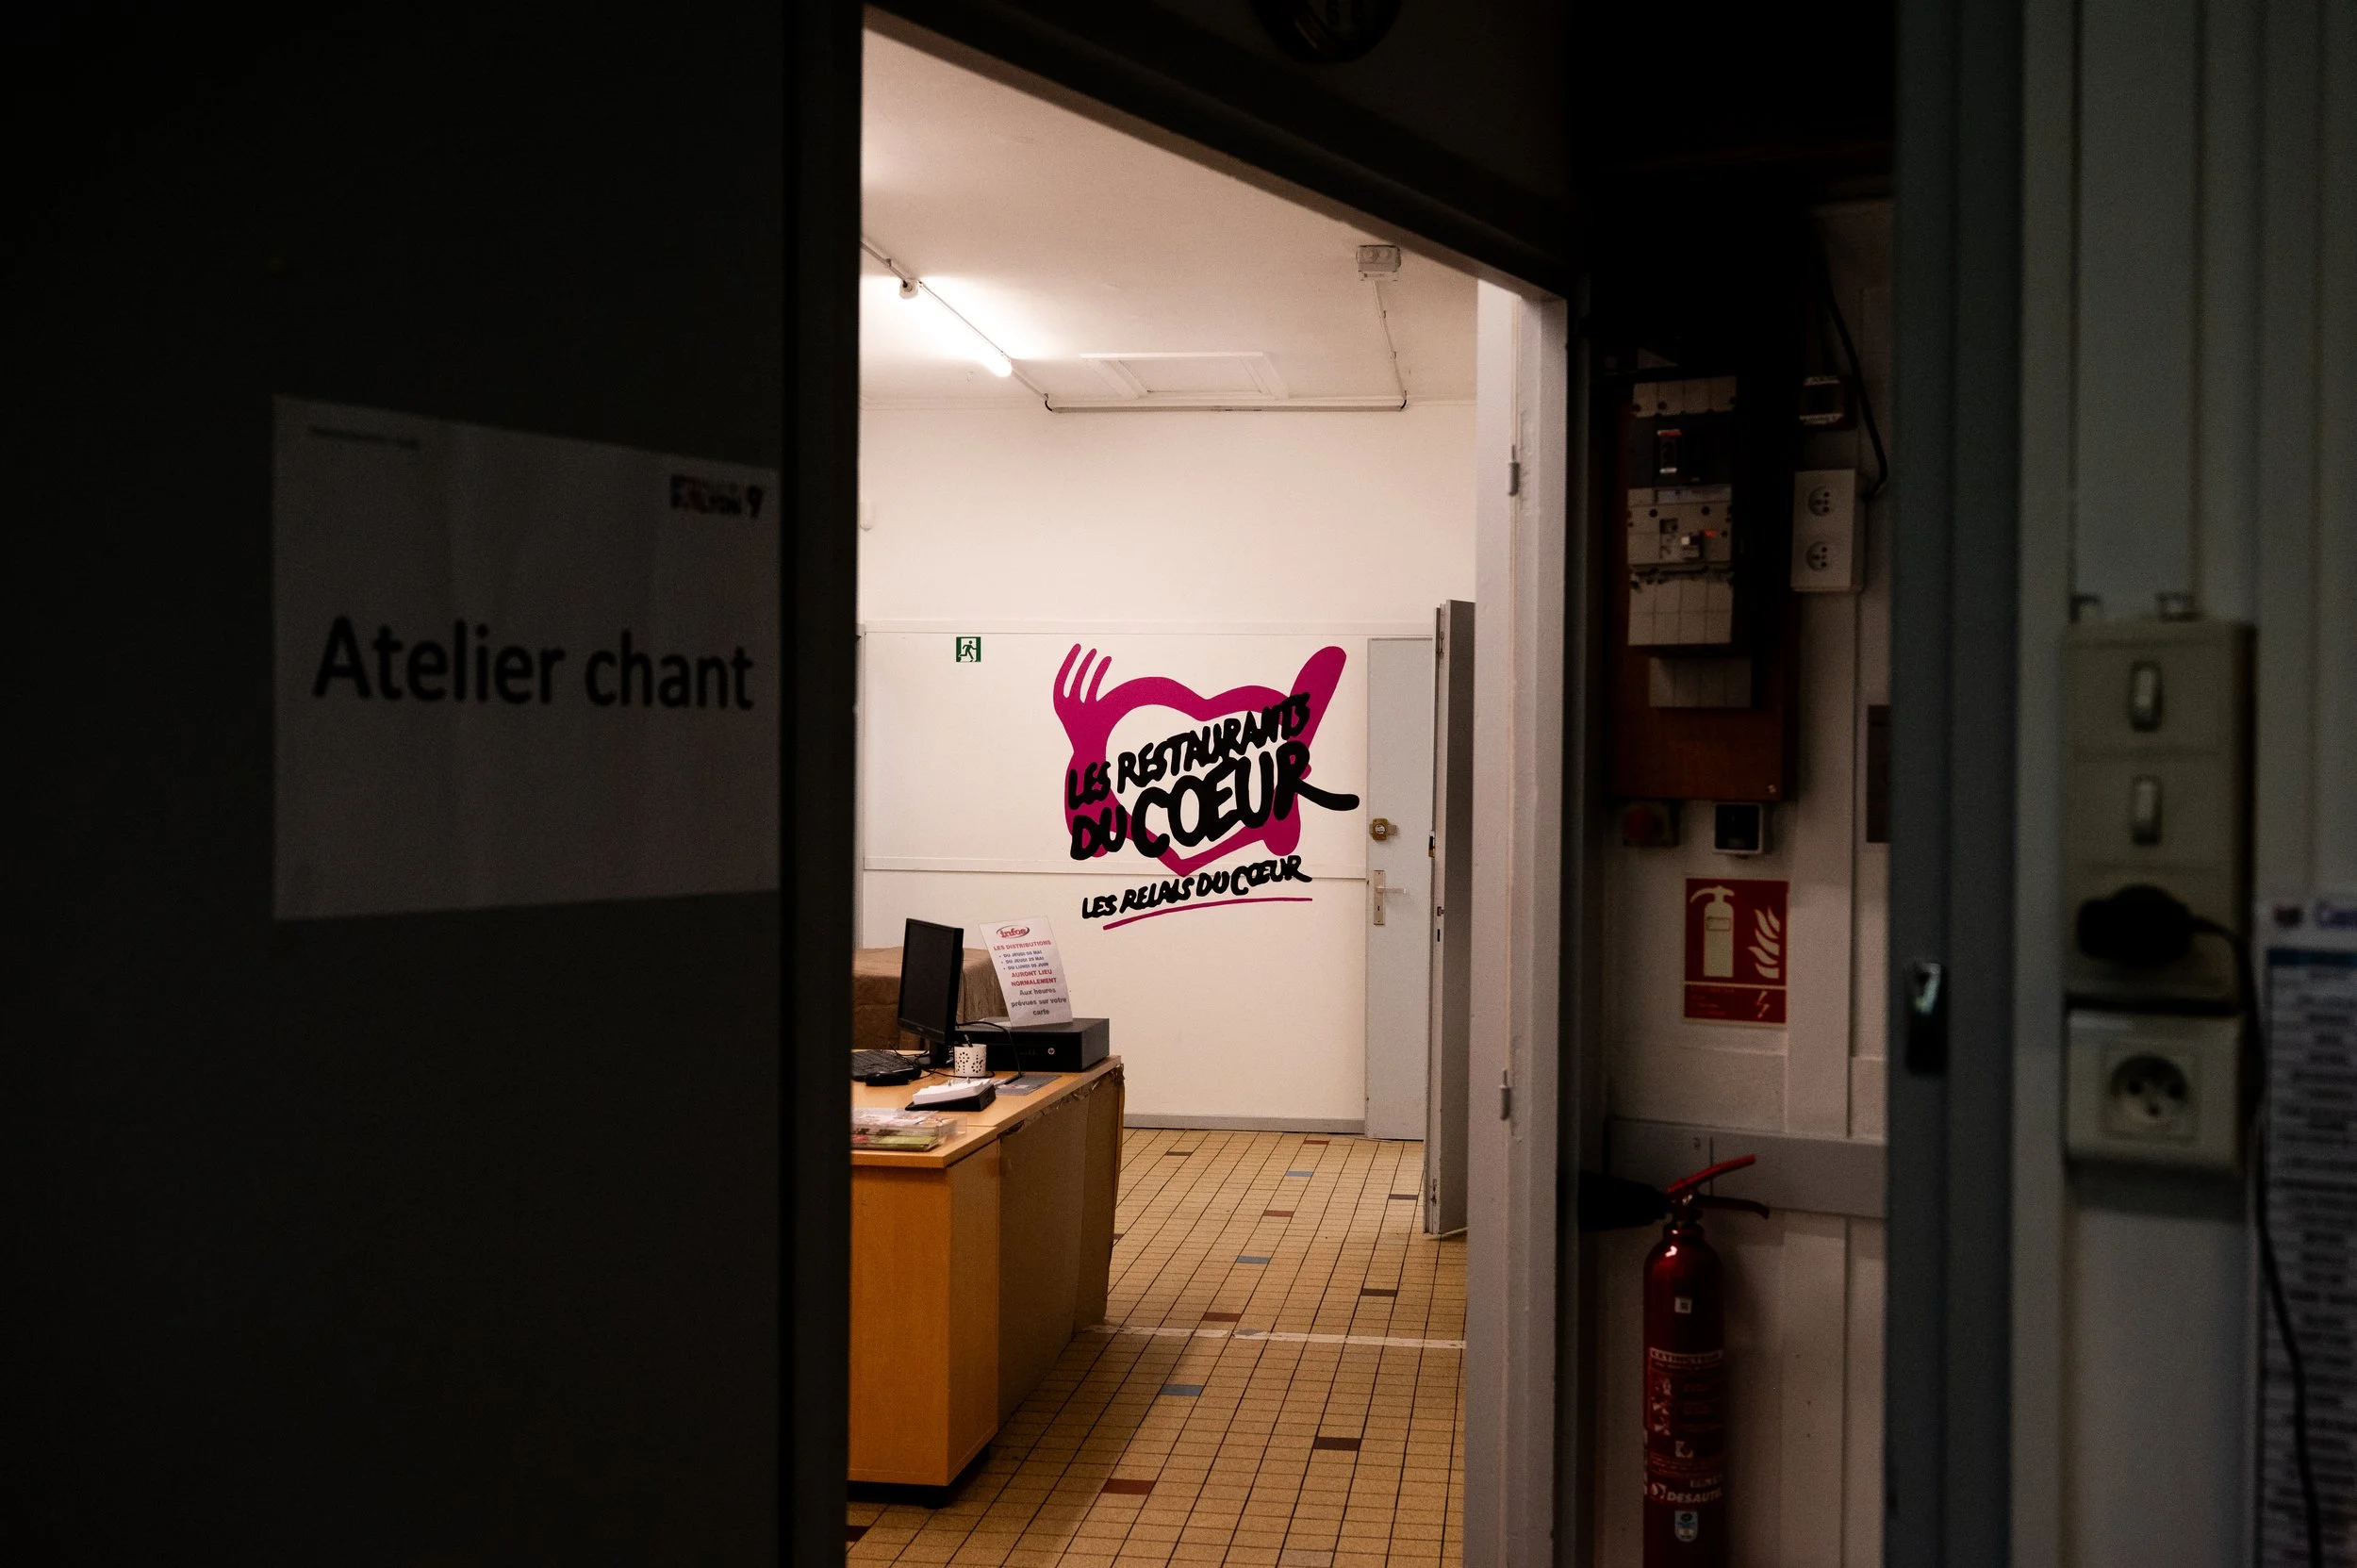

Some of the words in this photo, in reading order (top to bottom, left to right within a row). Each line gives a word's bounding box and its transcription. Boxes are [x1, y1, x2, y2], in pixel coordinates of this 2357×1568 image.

[313, 616, 565, 704] Atelier
[585, 629, 753, 709] chant
[1067, 762, 1112, 810] LES
[1117, 692, 1310, 793] RESTAURANTS
[1070, 803, 1128, 860] DU
[1082, 895, 1117, 918] LES
[1119, 876, 1194, 914] RELAIS
[1196, 870, 1229, 897] DU
[1000, 928, 1027, 938] infos
[1006, 940, 1052, 949] DISTRIBUTIONS
[1011, 977, 1057, 987] NORMALEMENT
